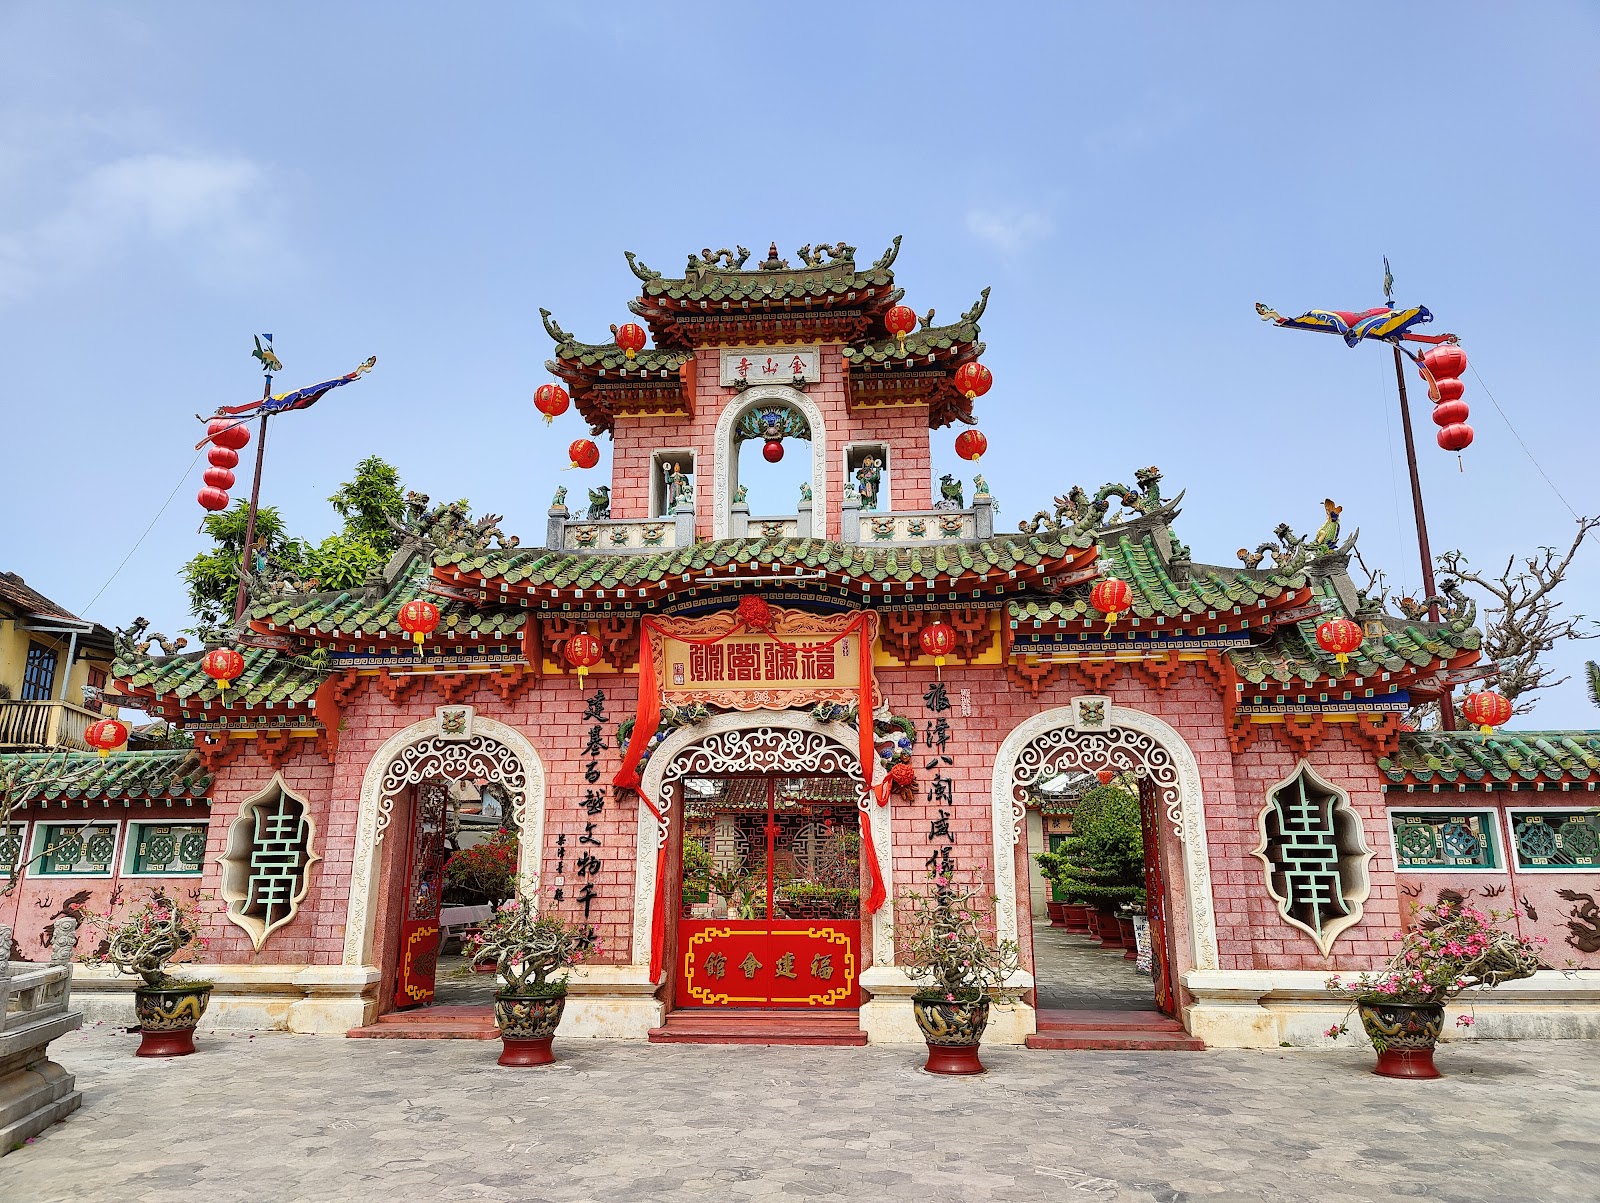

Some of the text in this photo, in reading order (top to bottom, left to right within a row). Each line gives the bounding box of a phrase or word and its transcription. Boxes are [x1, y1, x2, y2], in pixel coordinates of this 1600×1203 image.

[735, 355, 806, 377] 金山寺
[703, 951, 835, 980] 福建會館
